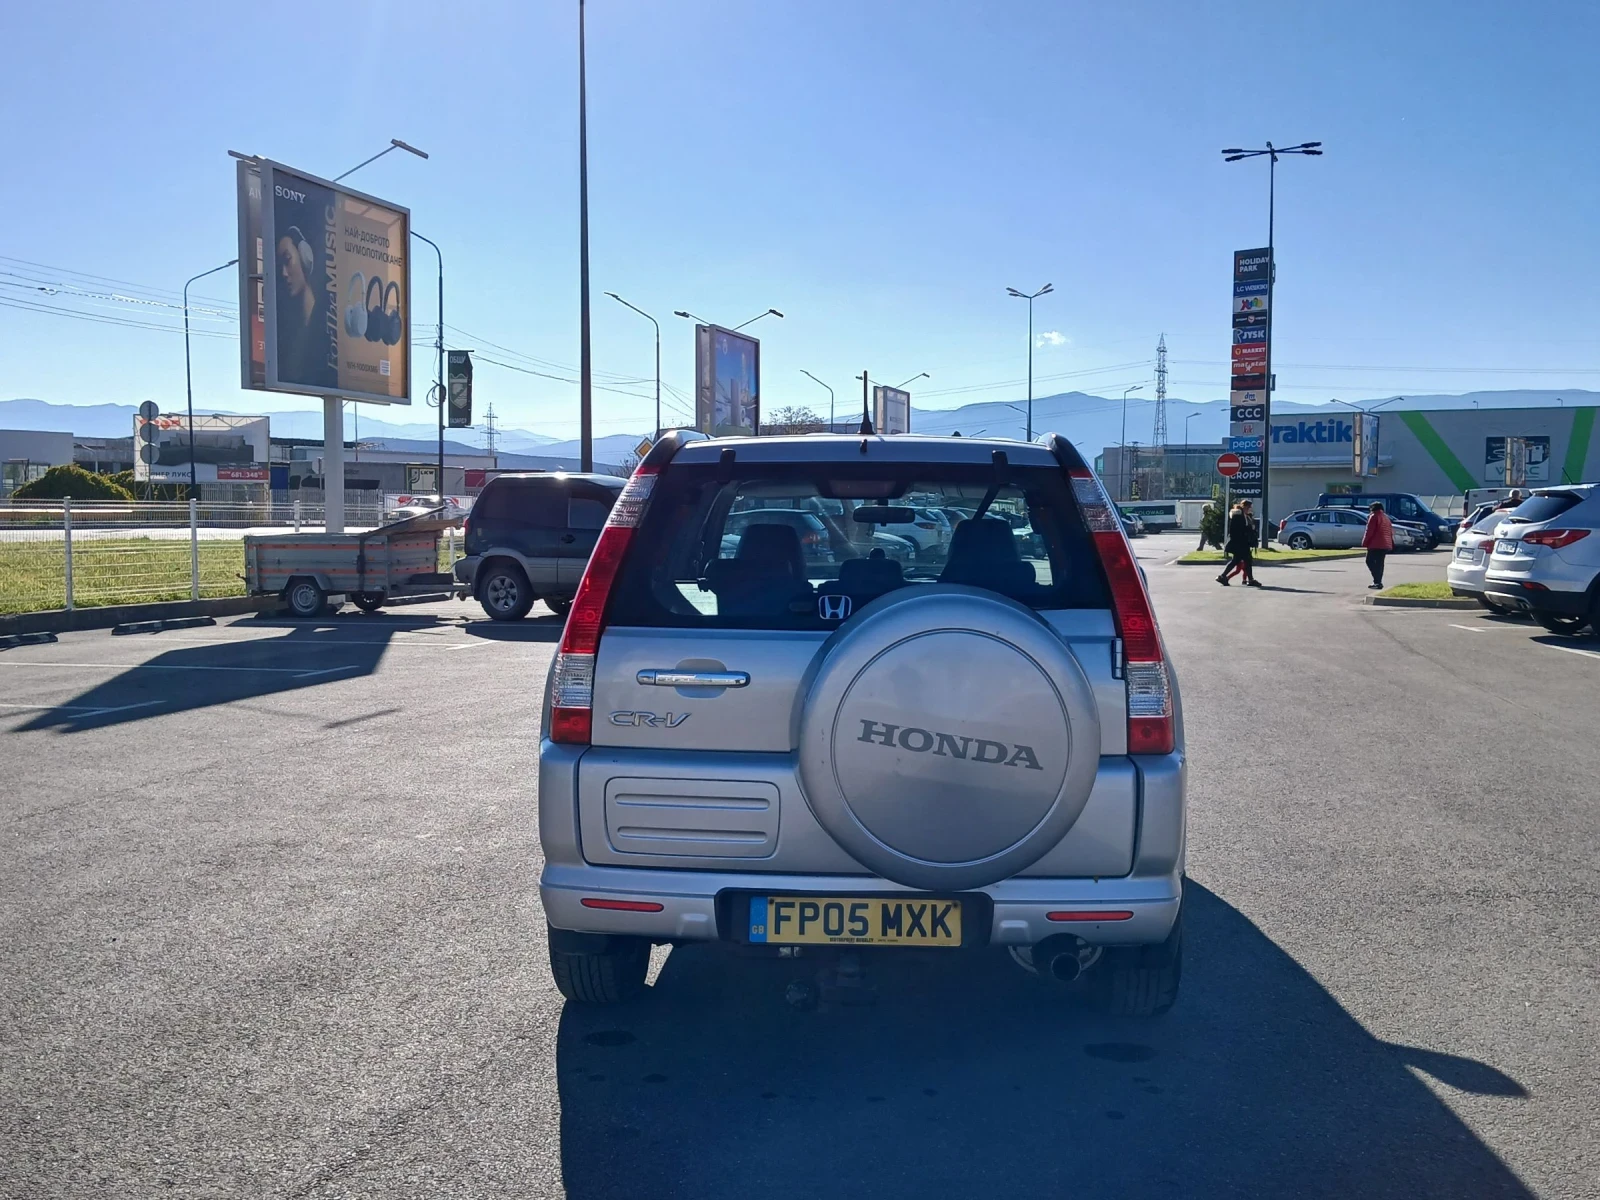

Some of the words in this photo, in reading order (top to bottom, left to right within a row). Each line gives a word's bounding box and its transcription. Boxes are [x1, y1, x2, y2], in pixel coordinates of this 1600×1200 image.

[275, 186, 305, 203] SONY
[344, 226, 390, 248] НАЙ-ДОБРОТО
[344, 242, 403, 267] ШУМОПОТИСКАНЕ
[1240, 256, 1269, 266] HOLIDAY
[1242, 330, 1265, 339] JYSK
[1245, 392, 1255, 400] dm
[1237, 408, 1261, 418] CCC
[1270, 419, 1352, 443] raktik
[1232, 440, 1262, 449] pepco
[1239, 455, 1261, 466] nsay
[608, 710, 692, 729] CR-V
[857, 719, 1044, 771] HONDA
[774, 901, 870, 937] FP05
[881, 903, 953, 938] MXK
[752, 925, 765, 935] GB
